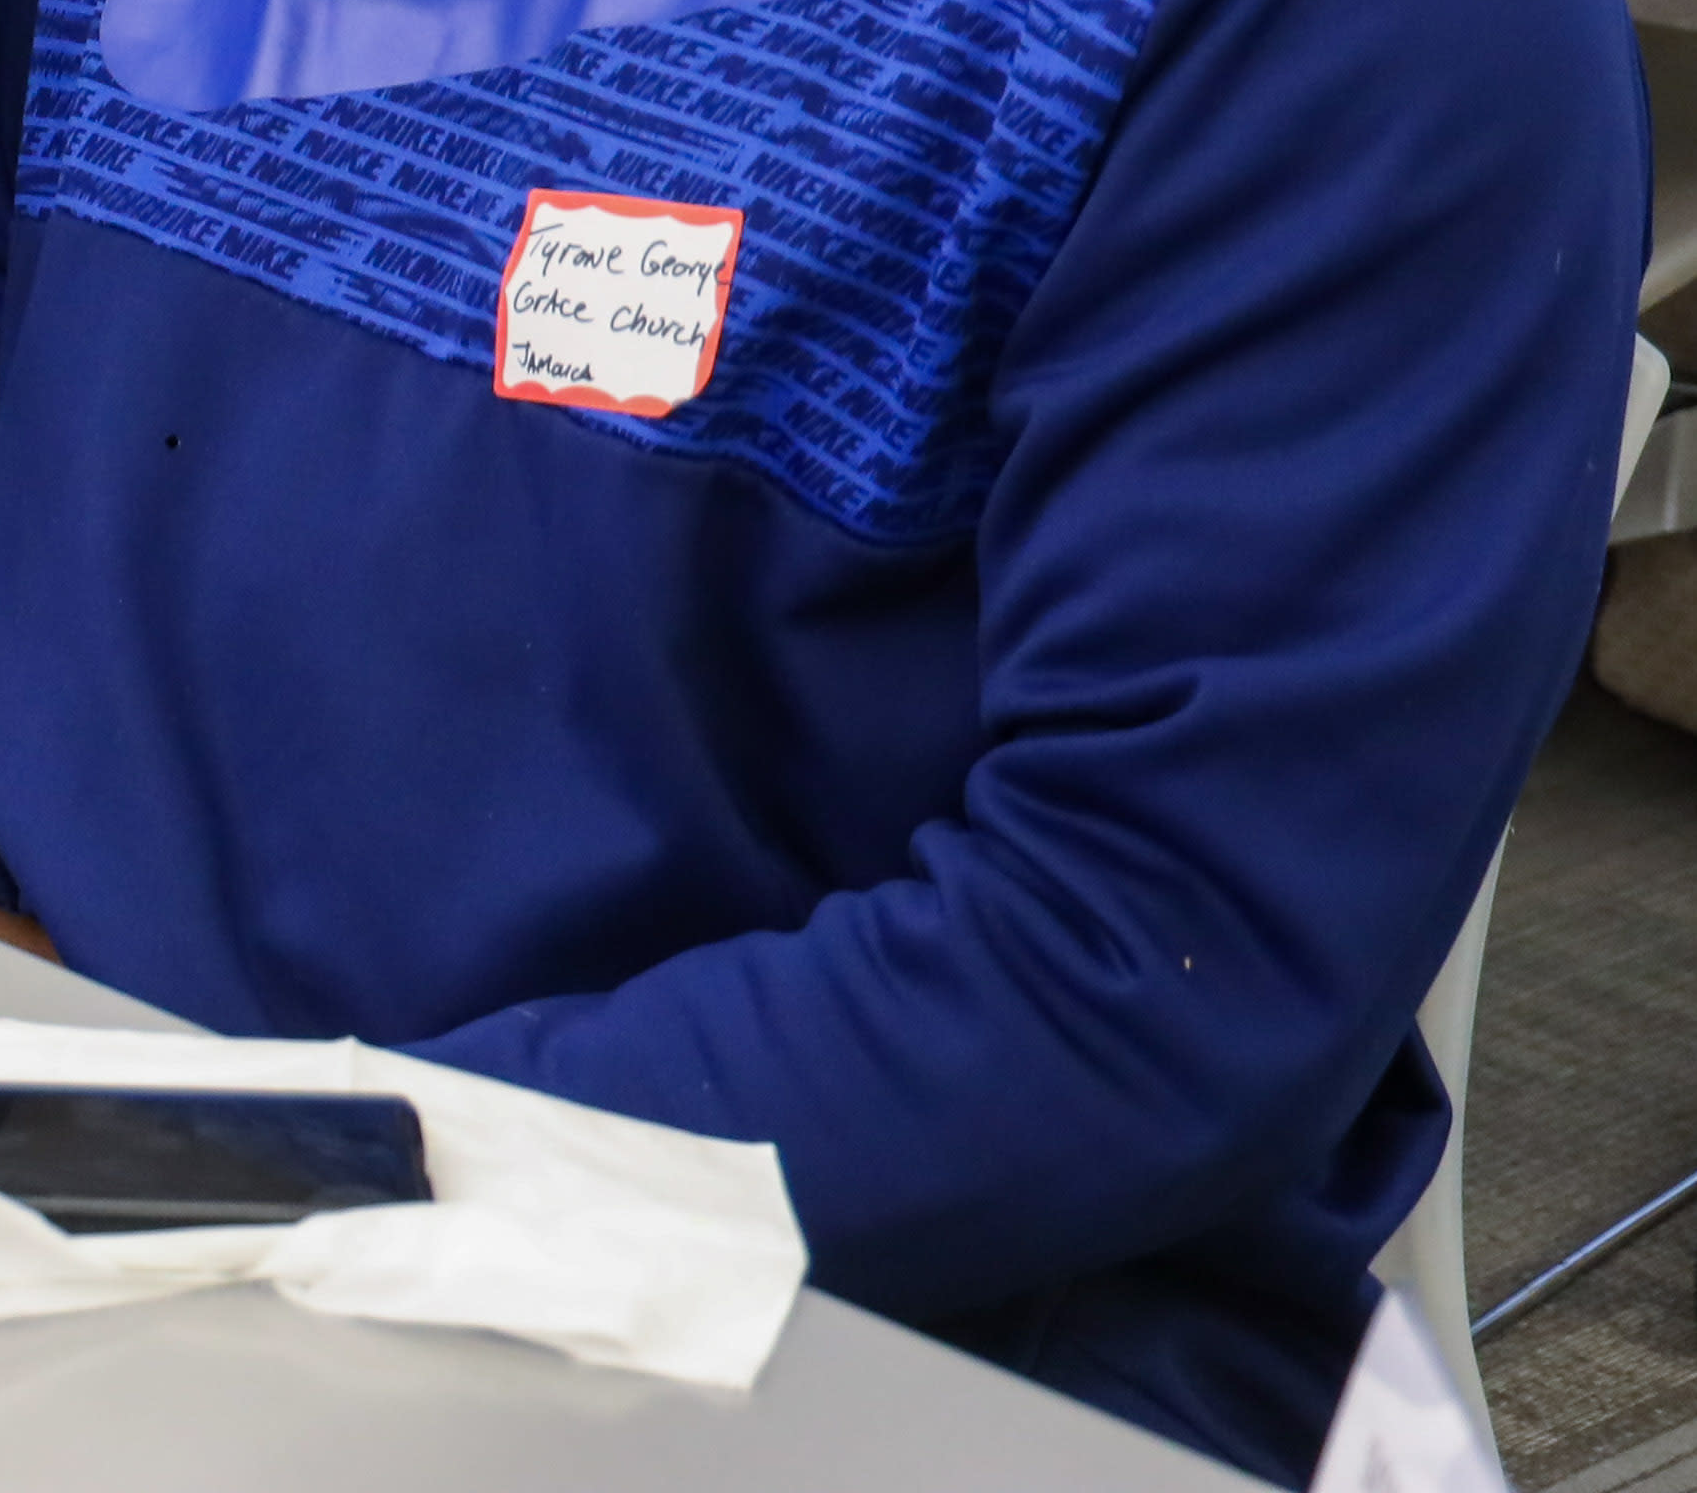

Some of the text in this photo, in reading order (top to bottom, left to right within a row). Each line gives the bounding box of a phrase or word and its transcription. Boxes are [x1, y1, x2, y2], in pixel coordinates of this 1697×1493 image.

[78, 134, 141, 175] NIKE
[180, 130, 255, 173] NIKE
[295, 130, 395, 183] NIKE
[389, 163, 472, 216] NIKE
[214, 226, 308, 281] NIKE
[641, 240, 732, 296] George
[611, 304, 706, 351] Church
